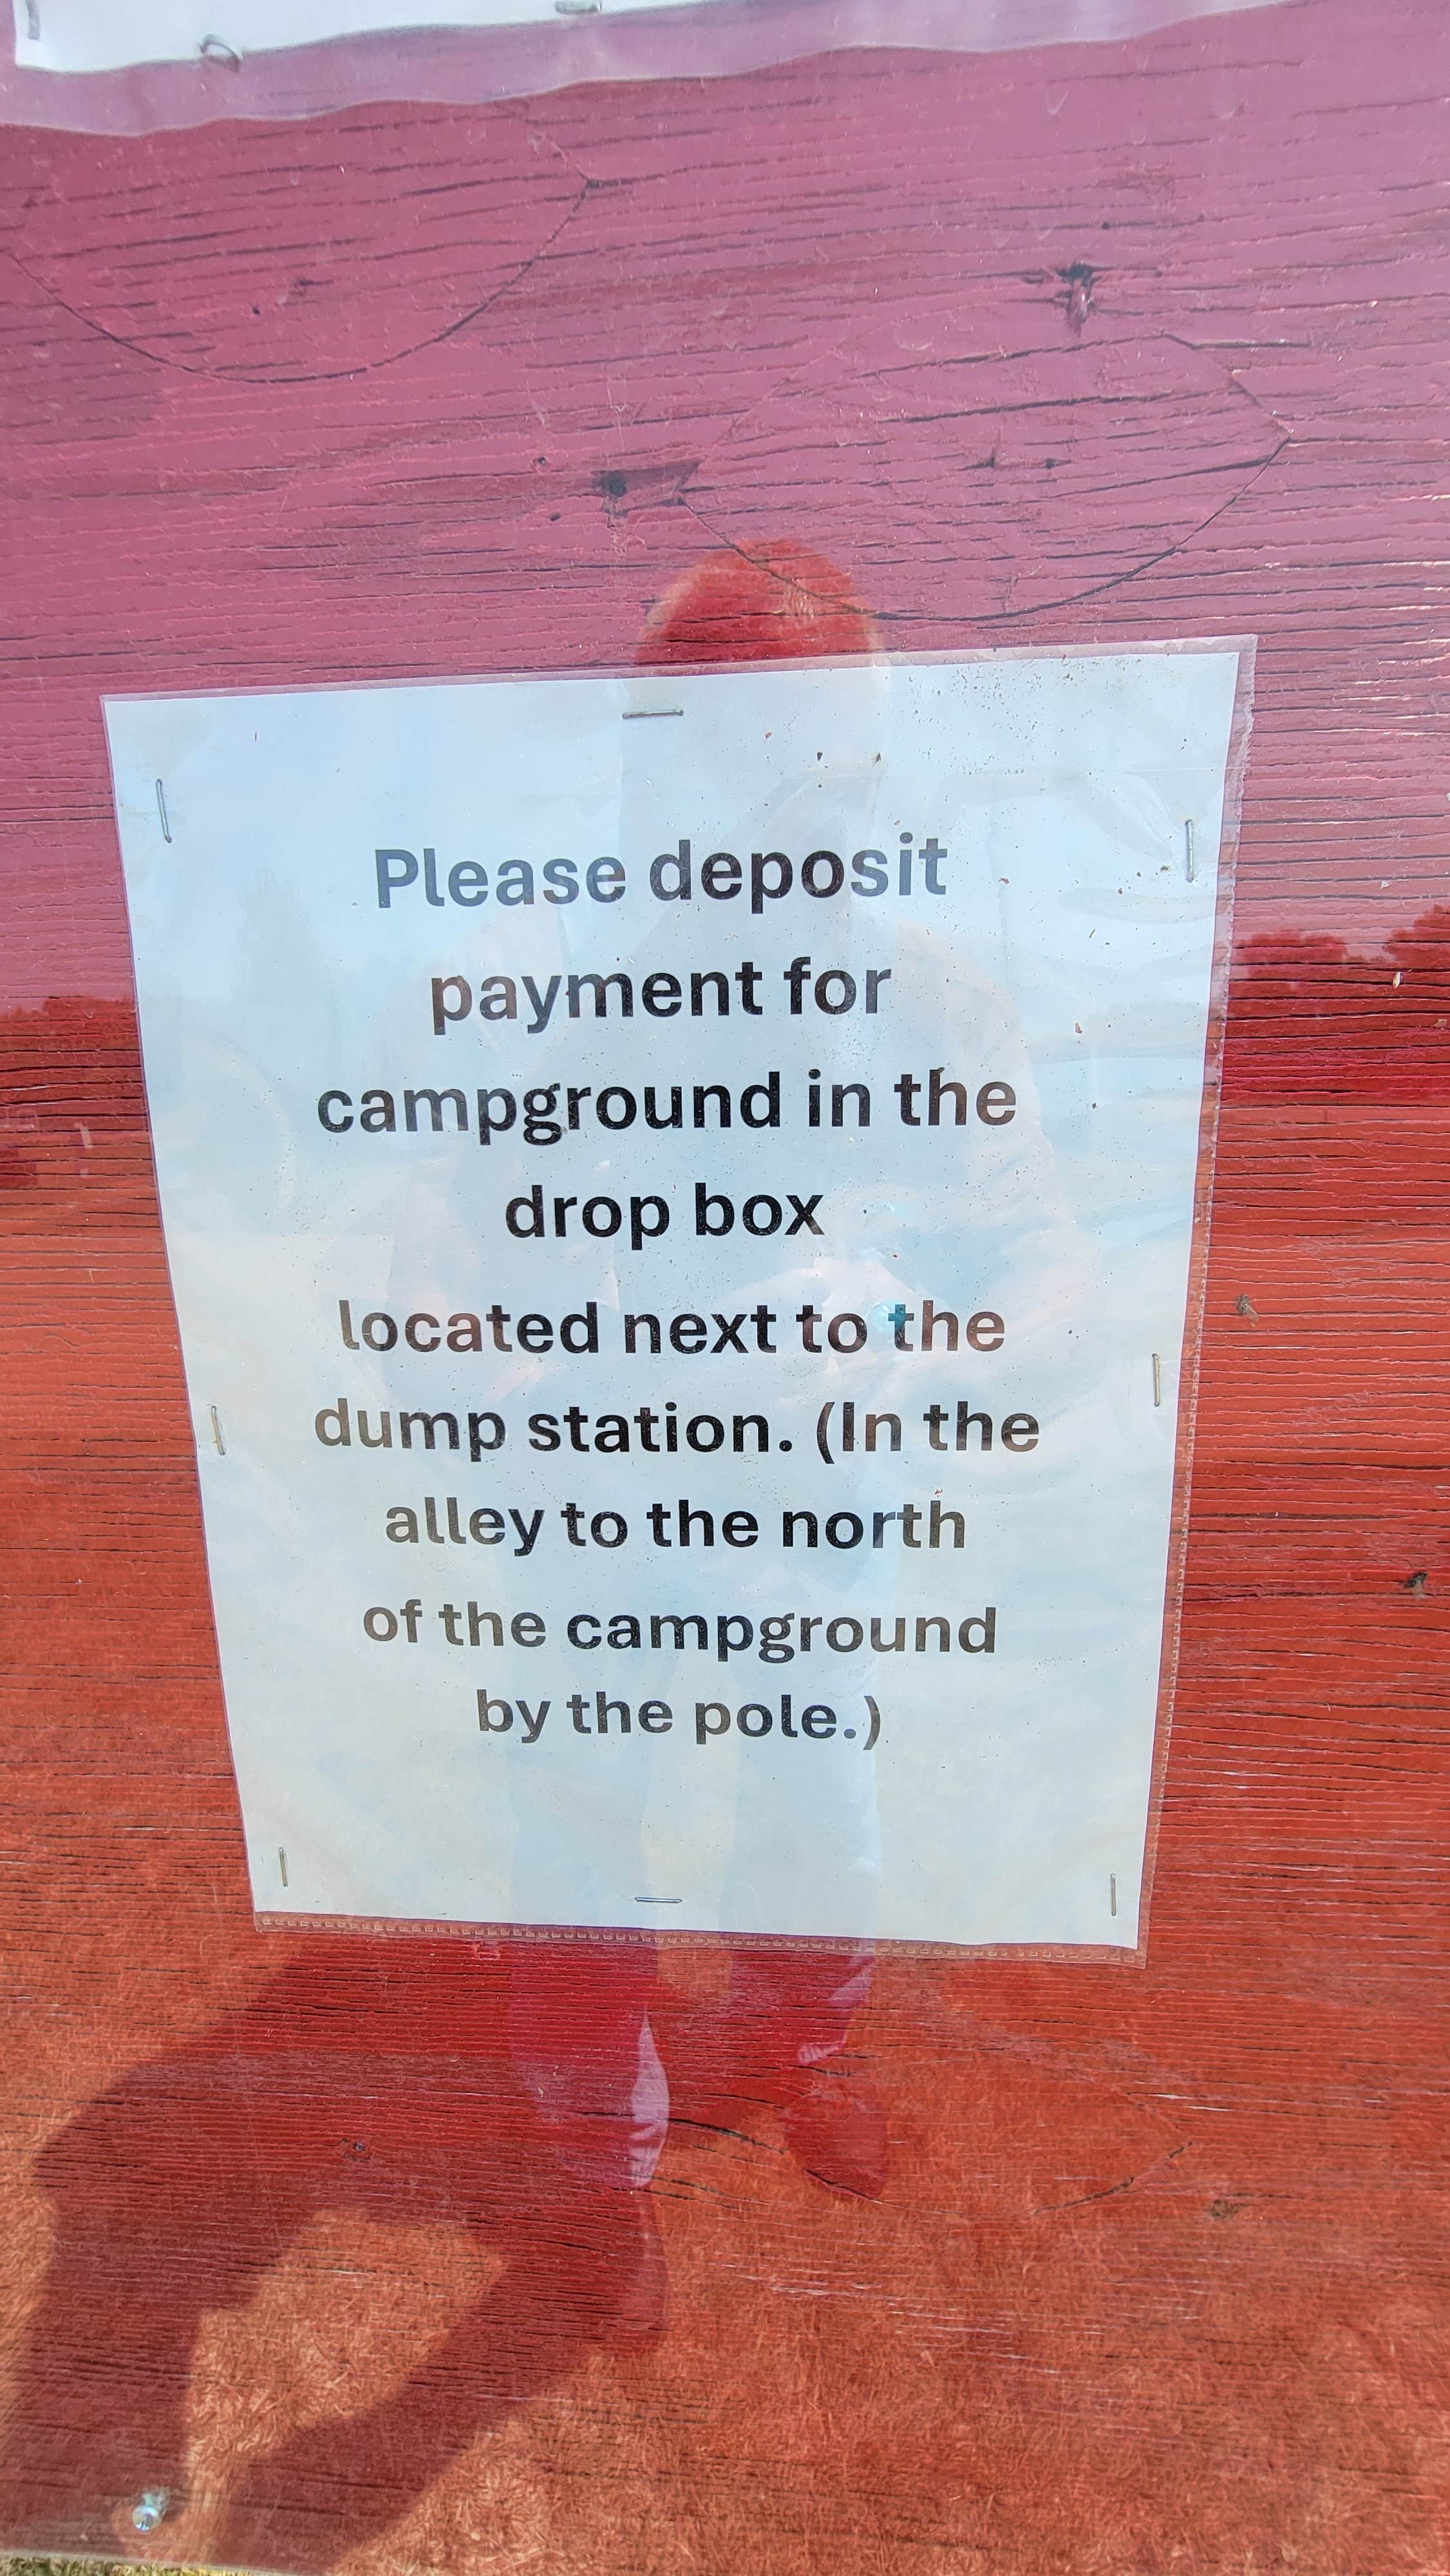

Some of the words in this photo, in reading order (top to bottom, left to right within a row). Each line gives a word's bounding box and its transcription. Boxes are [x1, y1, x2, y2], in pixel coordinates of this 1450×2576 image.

[375, 848, 625, 908] Please
[650, 832, 947, 914] deposit
[431, 961, 762, 1035] payment
[784, 956, 891, 1015] for
[315, 1071, 780, 1146] campground
[809, 1069, 870, 1127] in
[894, 1067, 1015, 1126] the
[505, 1185, 670, 1251] drop
[695, 1182, 824, 1236] box
[339, 1300, 598, 1354] located
[625, 1305, 777, 1354] next
[796, 1305, 867, 1353] to
[888, 1300, 1004, 1352] the
[315, 1398, 505, 1462] dump
[529, 1402, 792, 1453] station.
[816, 1402, 901, 1464] (In
[923, 1401, 1039, 1452] the
[386, 1497, 545, 1557] alley
[560, 1502, 628, 1548] to
[646, 1499, 758, 1548] the
[783, 1501, 965, 1549] north
[364, 1599, 422, 1643] of
[438, 1602, 546, 1647] the
[567, 1607, 996, 1663] campground
[477, 1689, 551, 1743] by
[567, 1691, 672, 1734] the
[695, 1694, 880, 1750] pole.)
